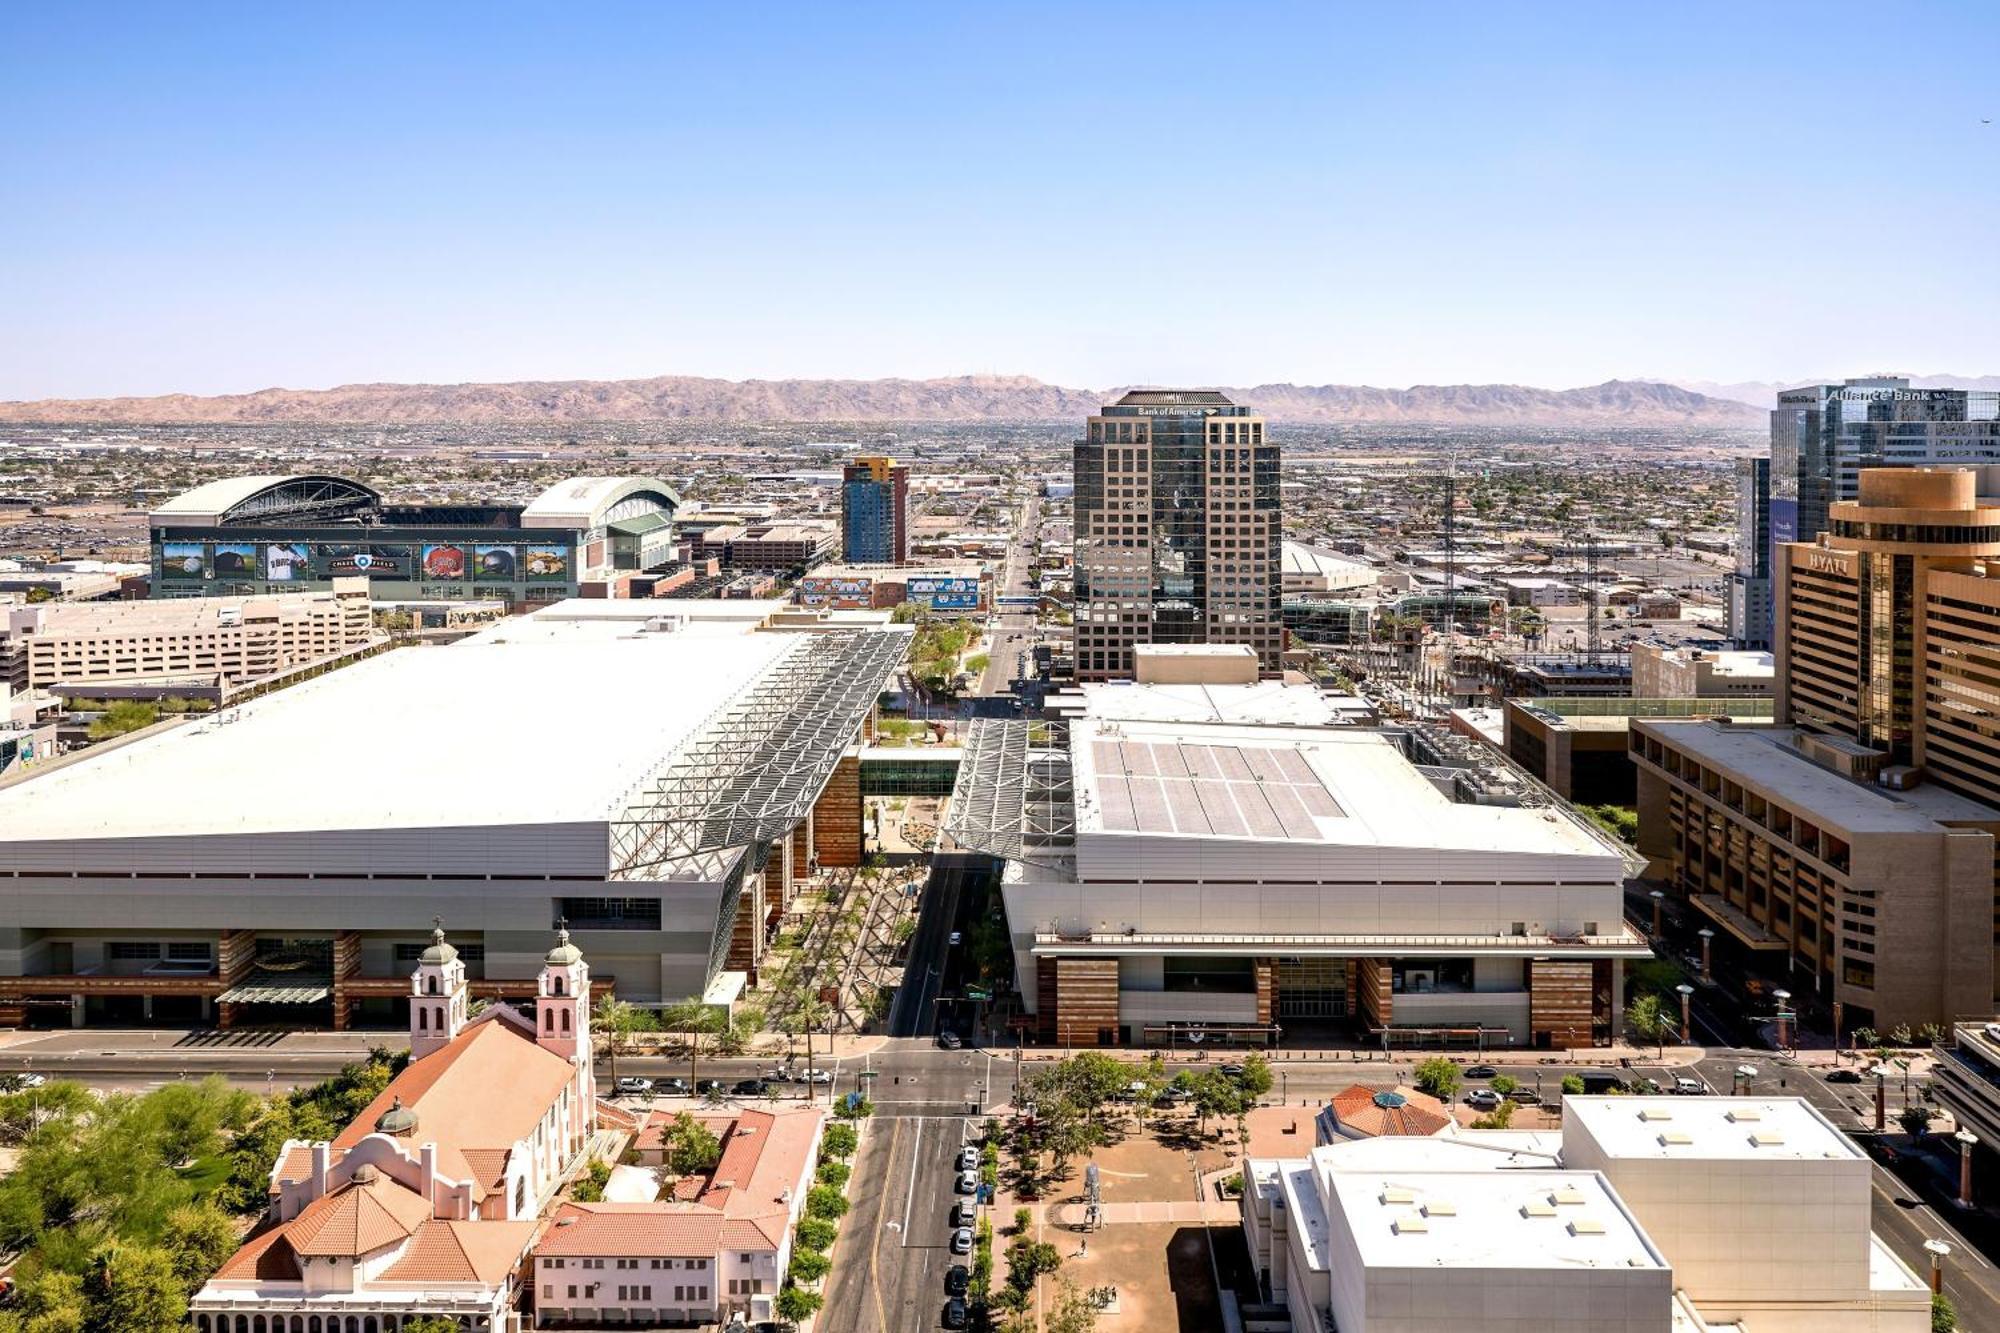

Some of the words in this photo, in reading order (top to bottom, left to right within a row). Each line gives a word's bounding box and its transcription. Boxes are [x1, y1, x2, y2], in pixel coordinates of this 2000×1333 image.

[1828, 390, 1889, 401] Alliance
[1894, 391, 1929, 401] Bank
[1138, 407, 1159, 416] Bank
[1159, 407, 1168, 416] of
[1169, 407, 1202, 416] America
[1810, 554, 1848, 573] HYATT
